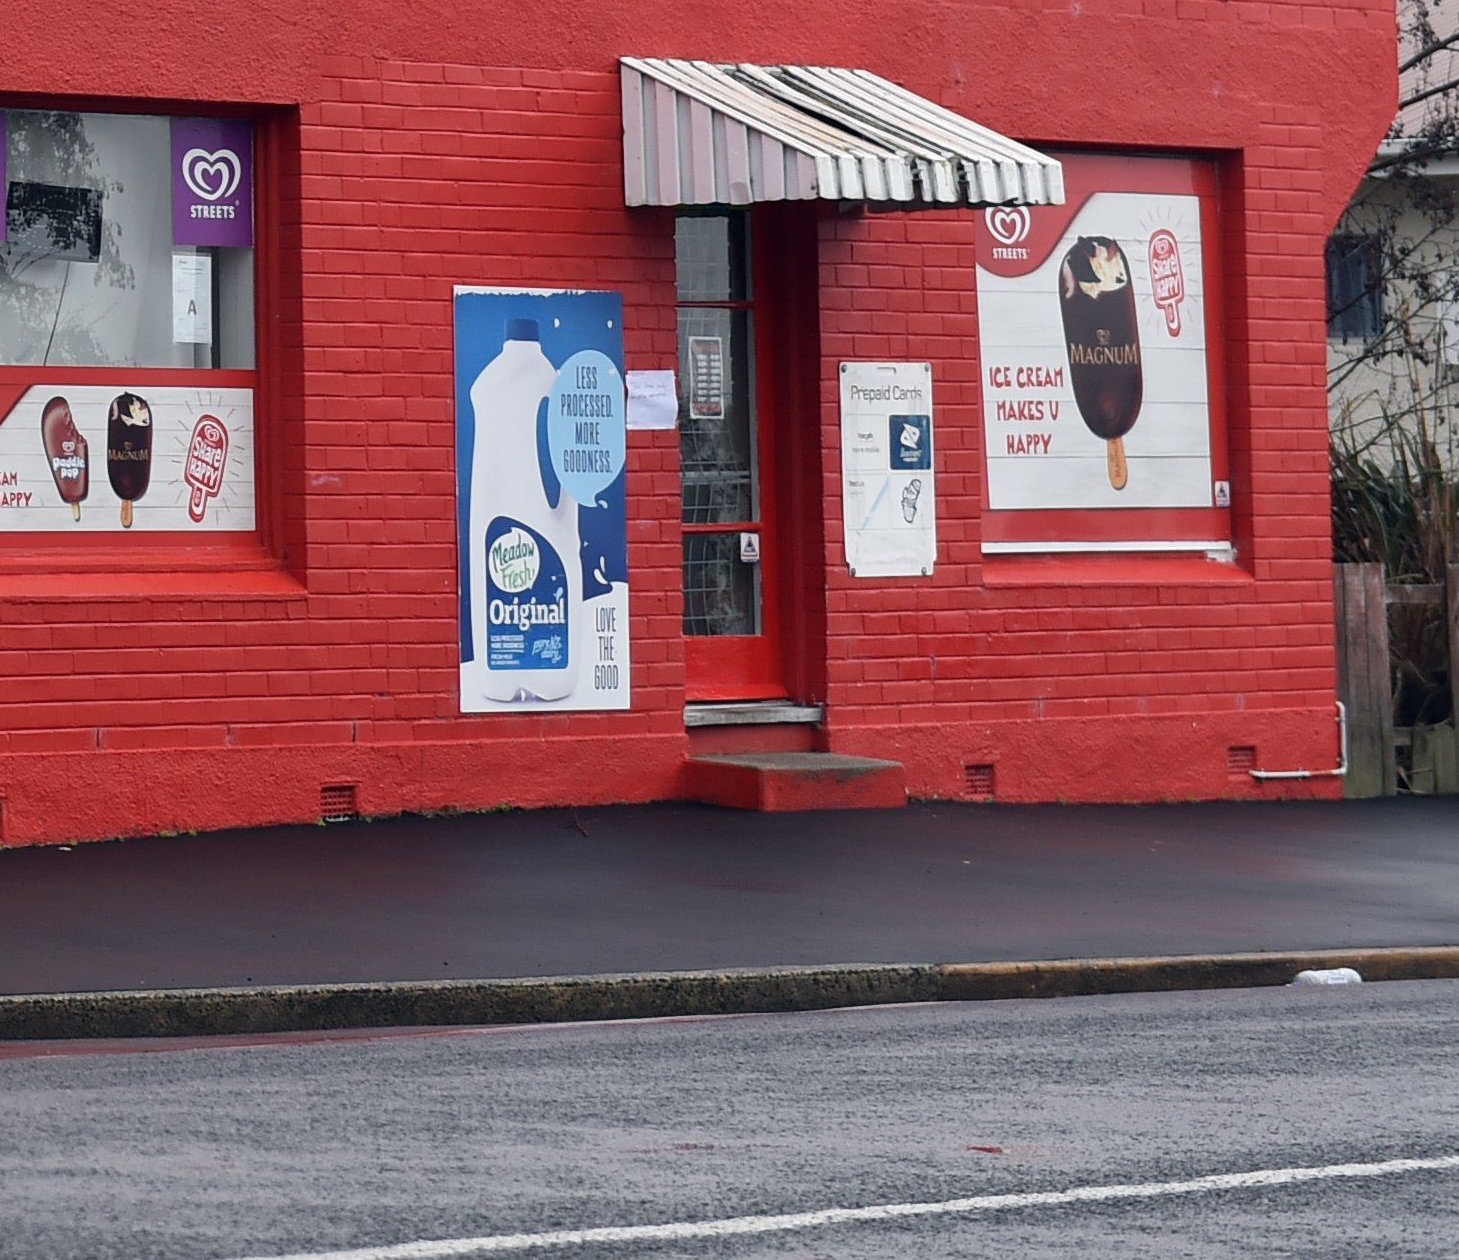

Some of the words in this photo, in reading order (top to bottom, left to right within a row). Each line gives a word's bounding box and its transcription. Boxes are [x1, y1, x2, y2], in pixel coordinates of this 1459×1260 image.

[190, 204, 235, 219] STREETS
[992, 247, 1028, 260] STREETS
[187, 299, 197, 315] A
[1070, 342, 1139, 365] MAGNUM
[576, 366, 598, 390] LESS
[989, 367, 1012, 389] ICE
[1016, 366, 1064, 389] CREAM
[850, 385, 891, 404] Prepaid
[892, 385, 922, 401] Cards
[996, 400, 1045, 422] MAKES
[1049, 400, 1060, 421] U
[575, 421, 600, 445] MORE
[1006, 433, 1052, 455] HAPPY
[108, 448, 149, 461] MAGNUM
[492, 533, 535, 573] Meadow
[500, 560, 532, 590] Fresh
[489, 597, 566, 631] Original
[595, 607, 617, 633] LOVE
[598, 636, 615, 661] THE
[594, 664, 619, 691] GOOD
